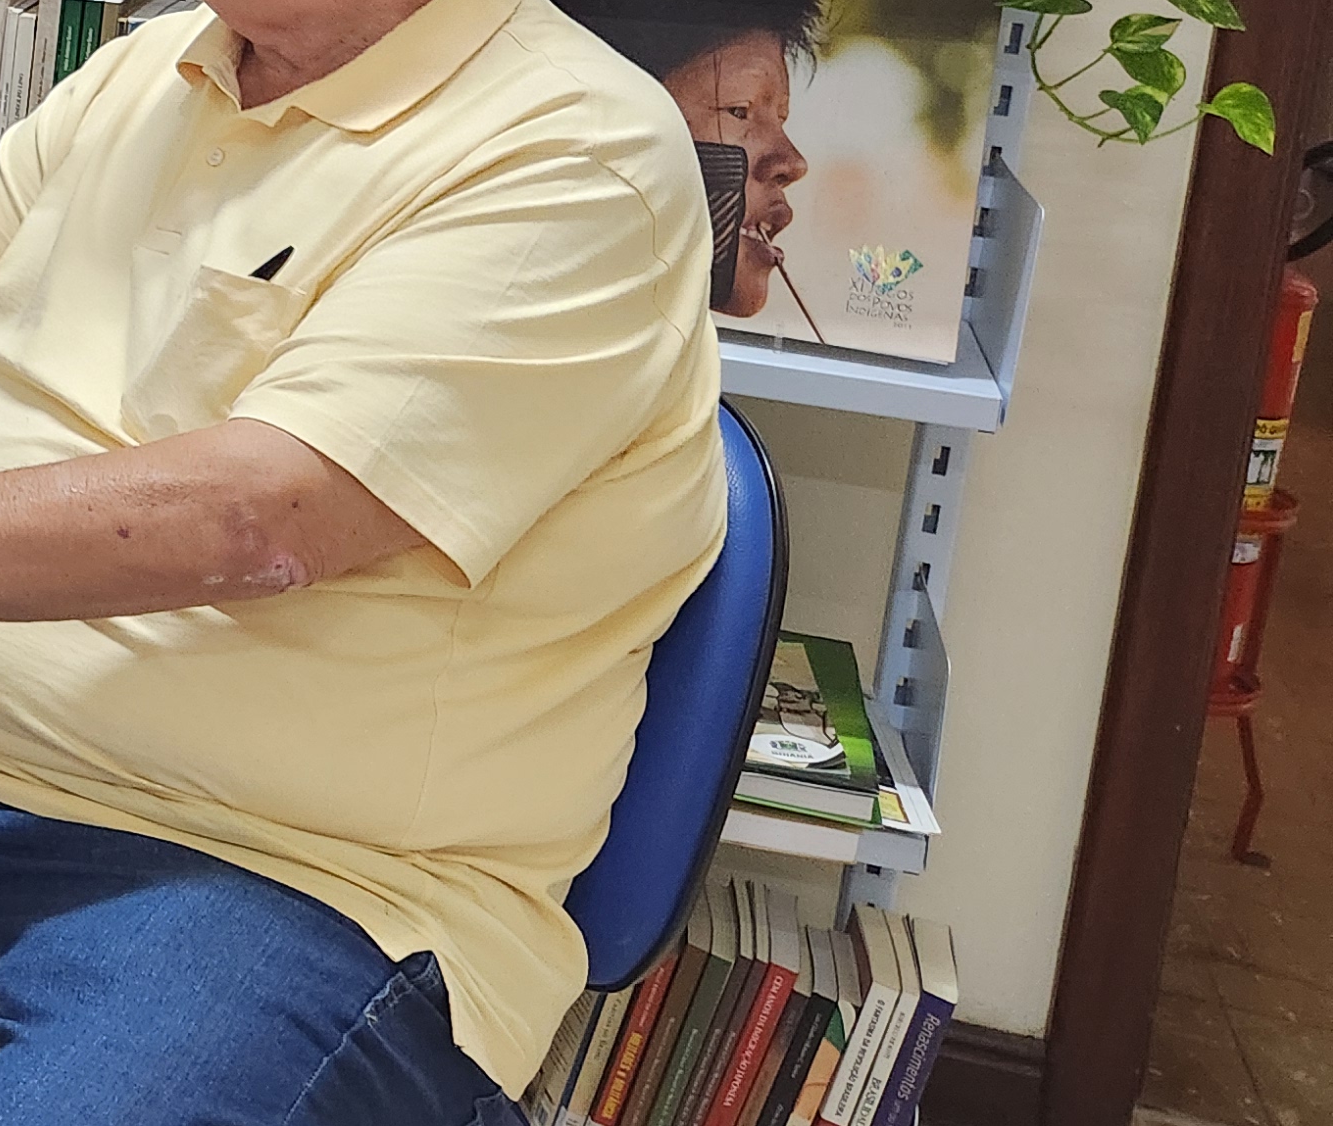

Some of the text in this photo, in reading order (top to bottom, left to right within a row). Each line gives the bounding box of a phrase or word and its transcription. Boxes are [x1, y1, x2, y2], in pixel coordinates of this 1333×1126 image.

[872, 296, 913, 313] POVOS
[722, 975, 785, 1107] CEM ANOS DA IMIGRAÇÃO JAPONESA
[896, 1013, 941, 1100] Renascimentos
